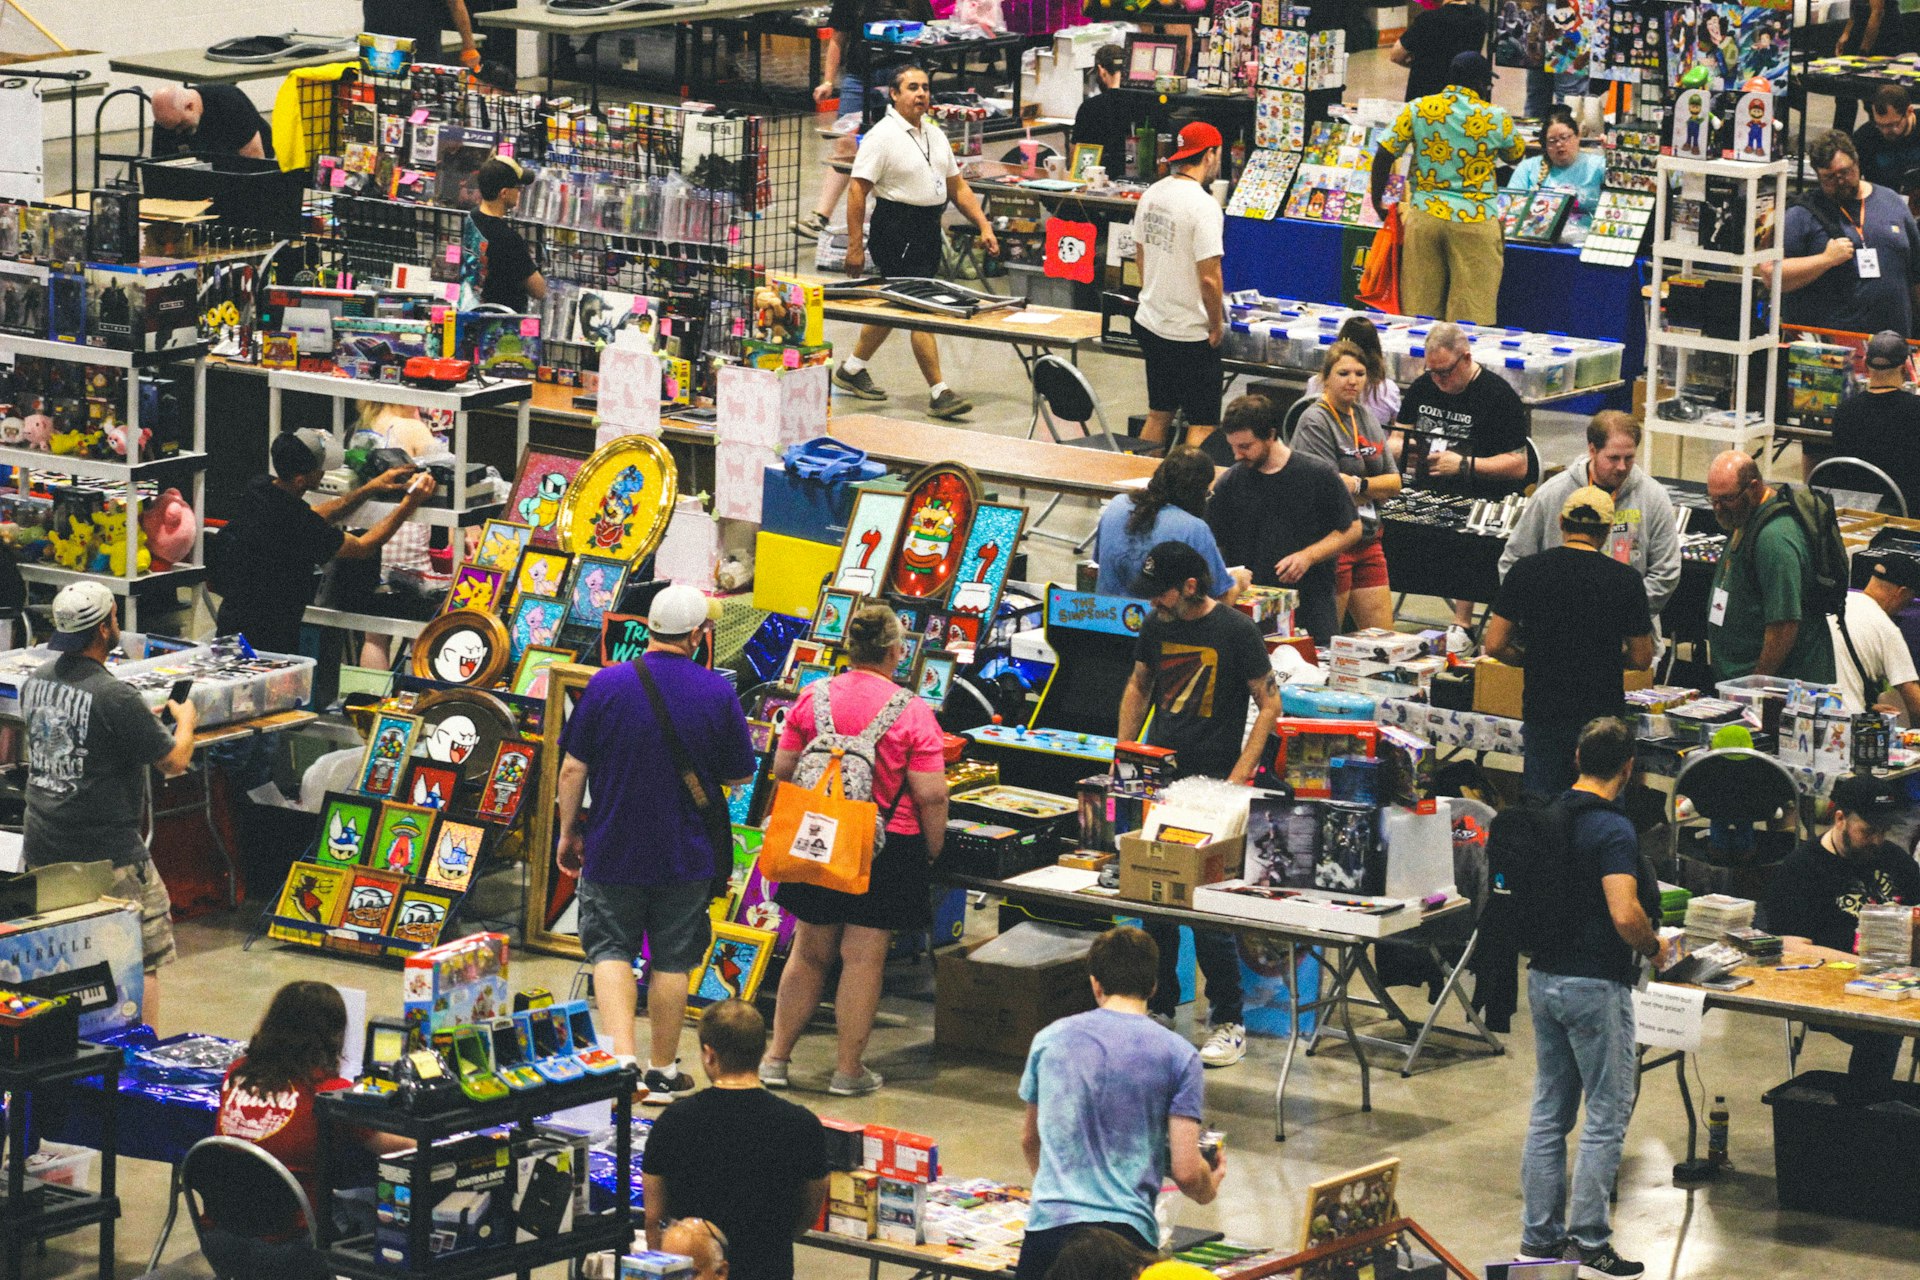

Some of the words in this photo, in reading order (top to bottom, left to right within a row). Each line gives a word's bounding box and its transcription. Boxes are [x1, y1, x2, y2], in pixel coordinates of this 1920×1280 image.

[1418, 403, 1444, 420] COIN
[1071, 597, 1097, 609] THE
[1058, 606, 1118, 623] SIMPSONS
[623, 620, 651, 642] TRA
[10, 936, 93, 966] MIRACLE
[456, 1172, 488, 1189] CONTROL
